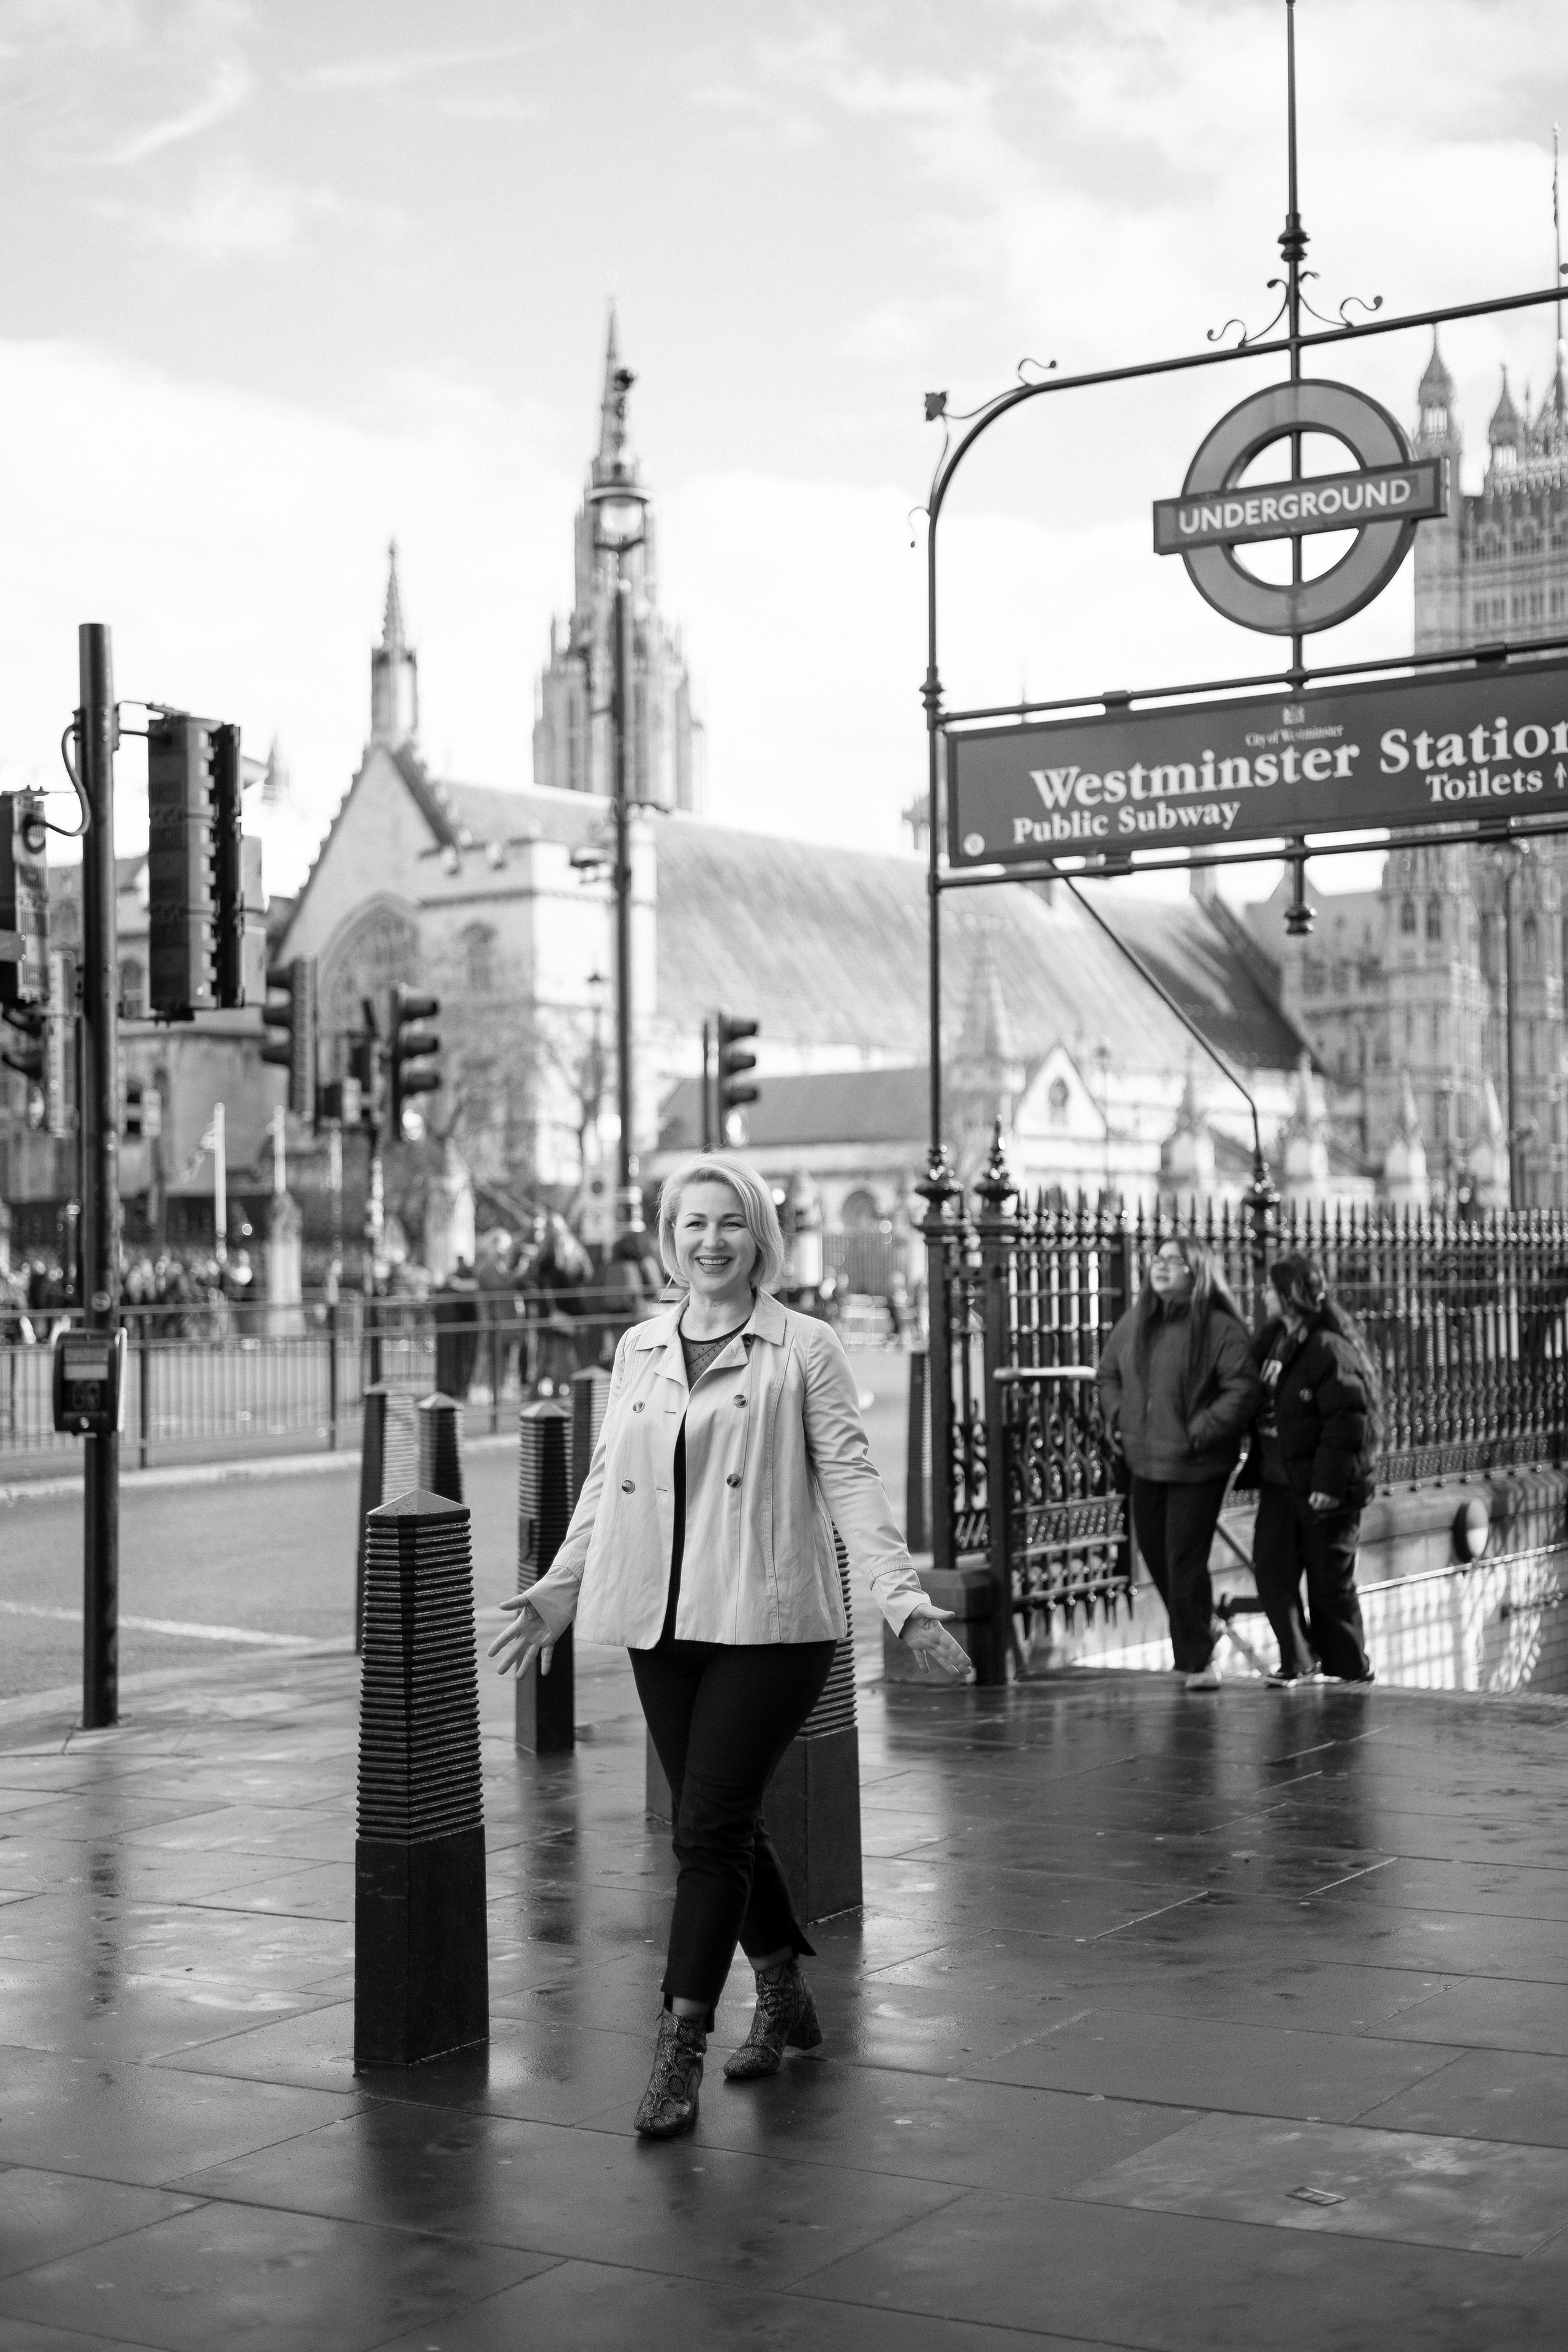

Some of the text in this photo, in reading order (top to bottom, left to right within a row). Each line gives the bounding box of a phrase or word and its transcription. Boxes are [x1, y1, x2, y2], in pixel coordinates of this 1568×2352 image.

[1179, 479, 1411, 534] UNDERGROUND
[1028, 744, 1360, 810] Westminster
[1425, 767, 1544, 802] Toilets
[1012, 801, 1242, 844] Public Subway
